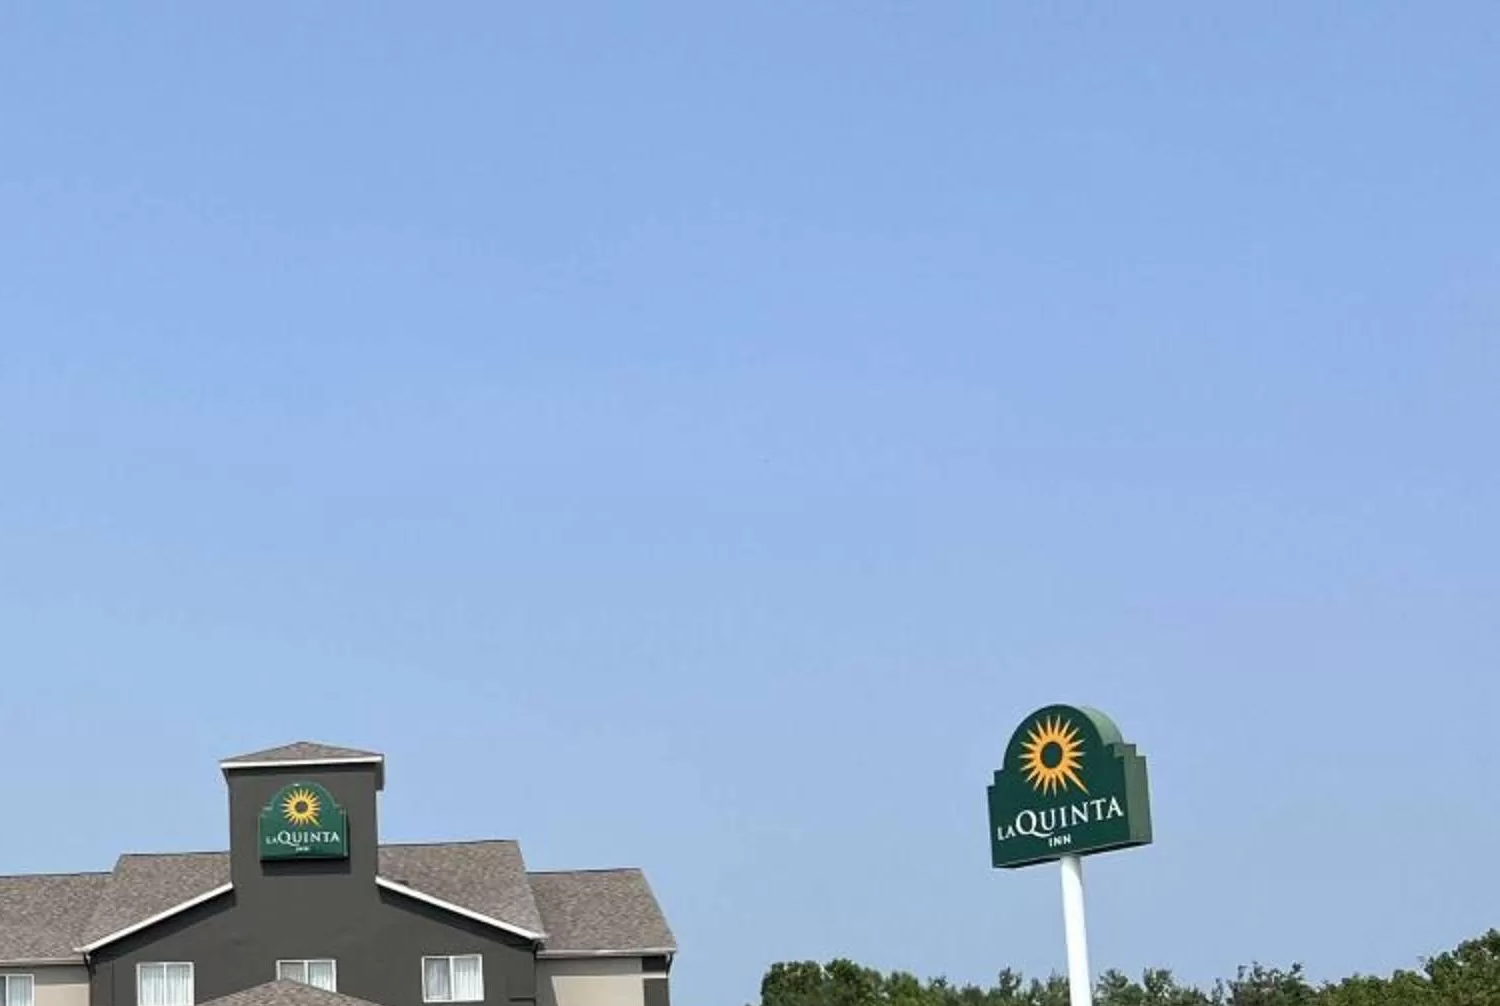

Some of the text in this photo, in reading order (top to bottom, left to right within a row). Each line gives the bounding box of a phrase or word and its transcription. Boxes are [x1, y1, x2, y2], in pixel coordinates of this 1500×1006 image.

[997, 796, 1124, 841] LA QUINTA
[277, 830, 340, 847] QUINTA
[1049, 833, 1072, 847] INN
